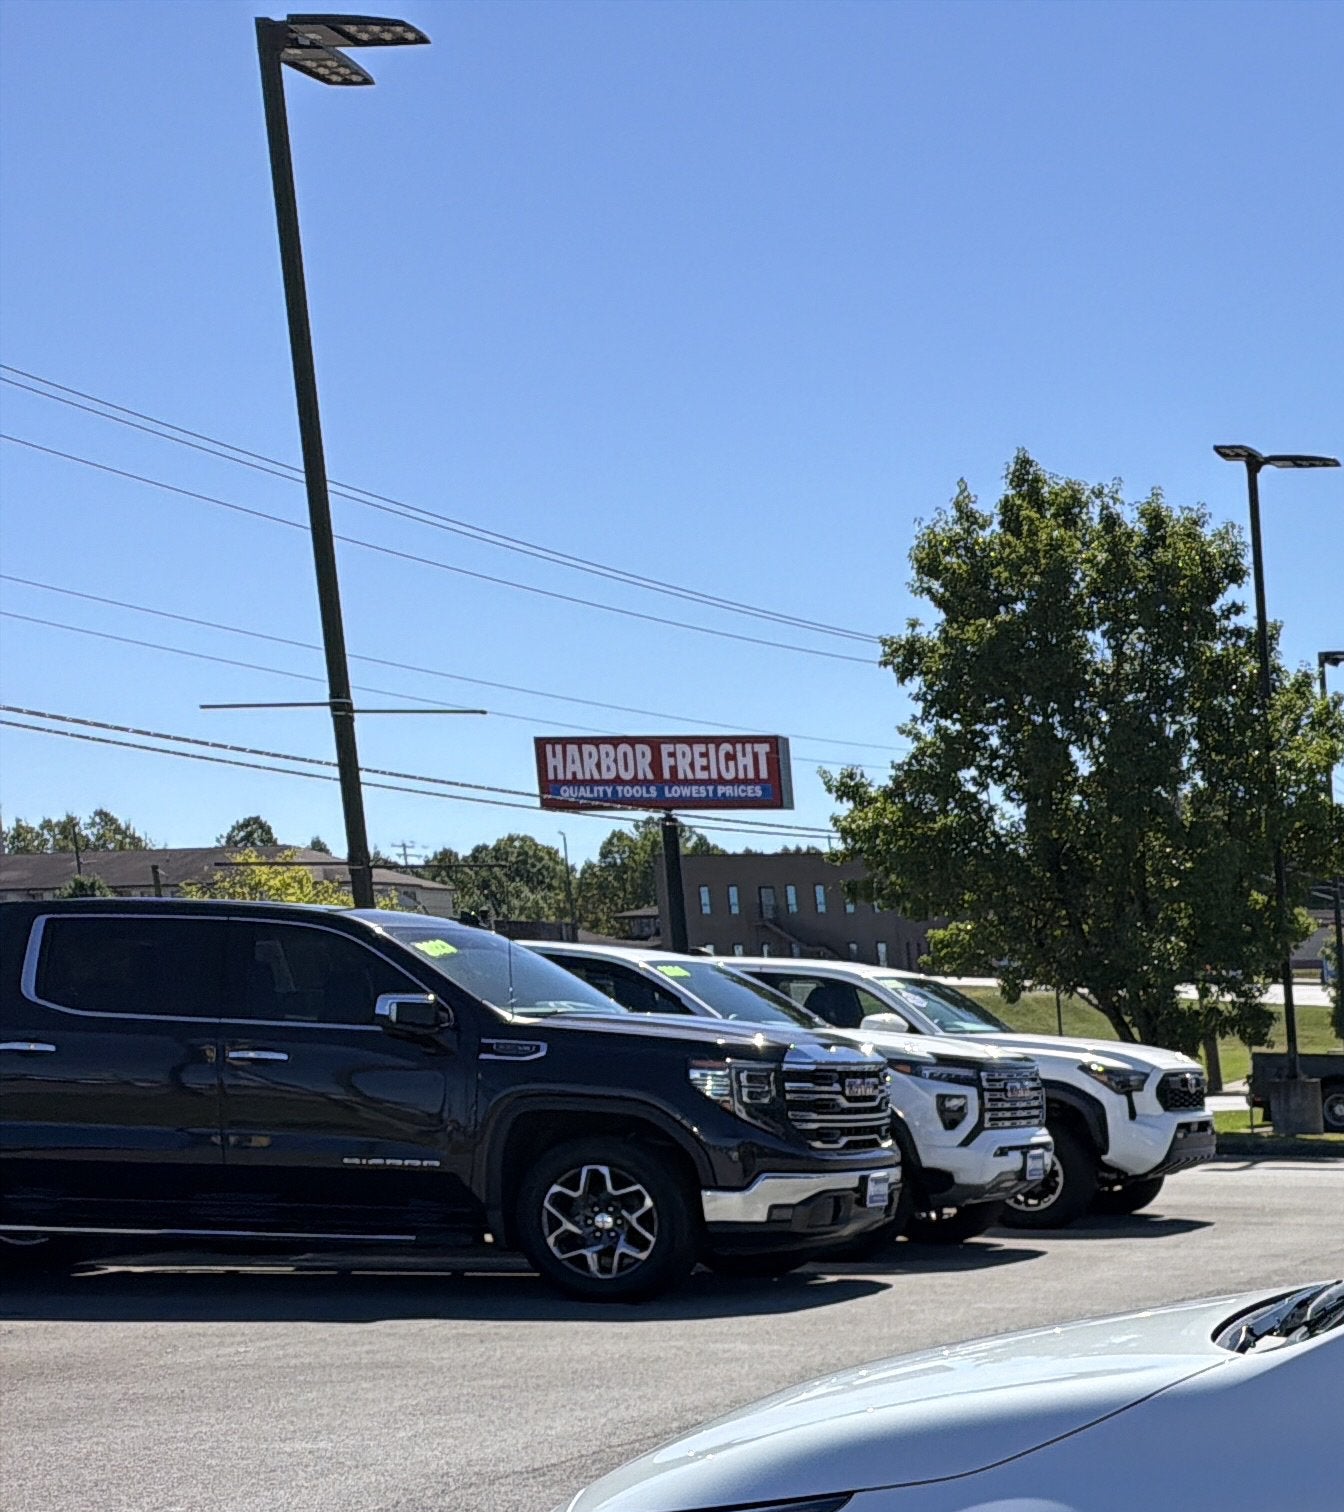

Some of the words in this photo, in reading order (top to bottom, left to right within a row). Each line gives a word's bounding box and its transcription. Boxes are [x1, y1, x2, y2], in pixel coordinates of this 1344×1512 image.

[546, 743, 654, 780] HARBOR
[660, 743, 770, 780] FREIGHT
[560, 786, 613, 798] QUALITY
[616, 786, 657, 798] TOOLS
[664, 785, 717, 798] LOWEST
[718, 785, 763, 798] PRICES
